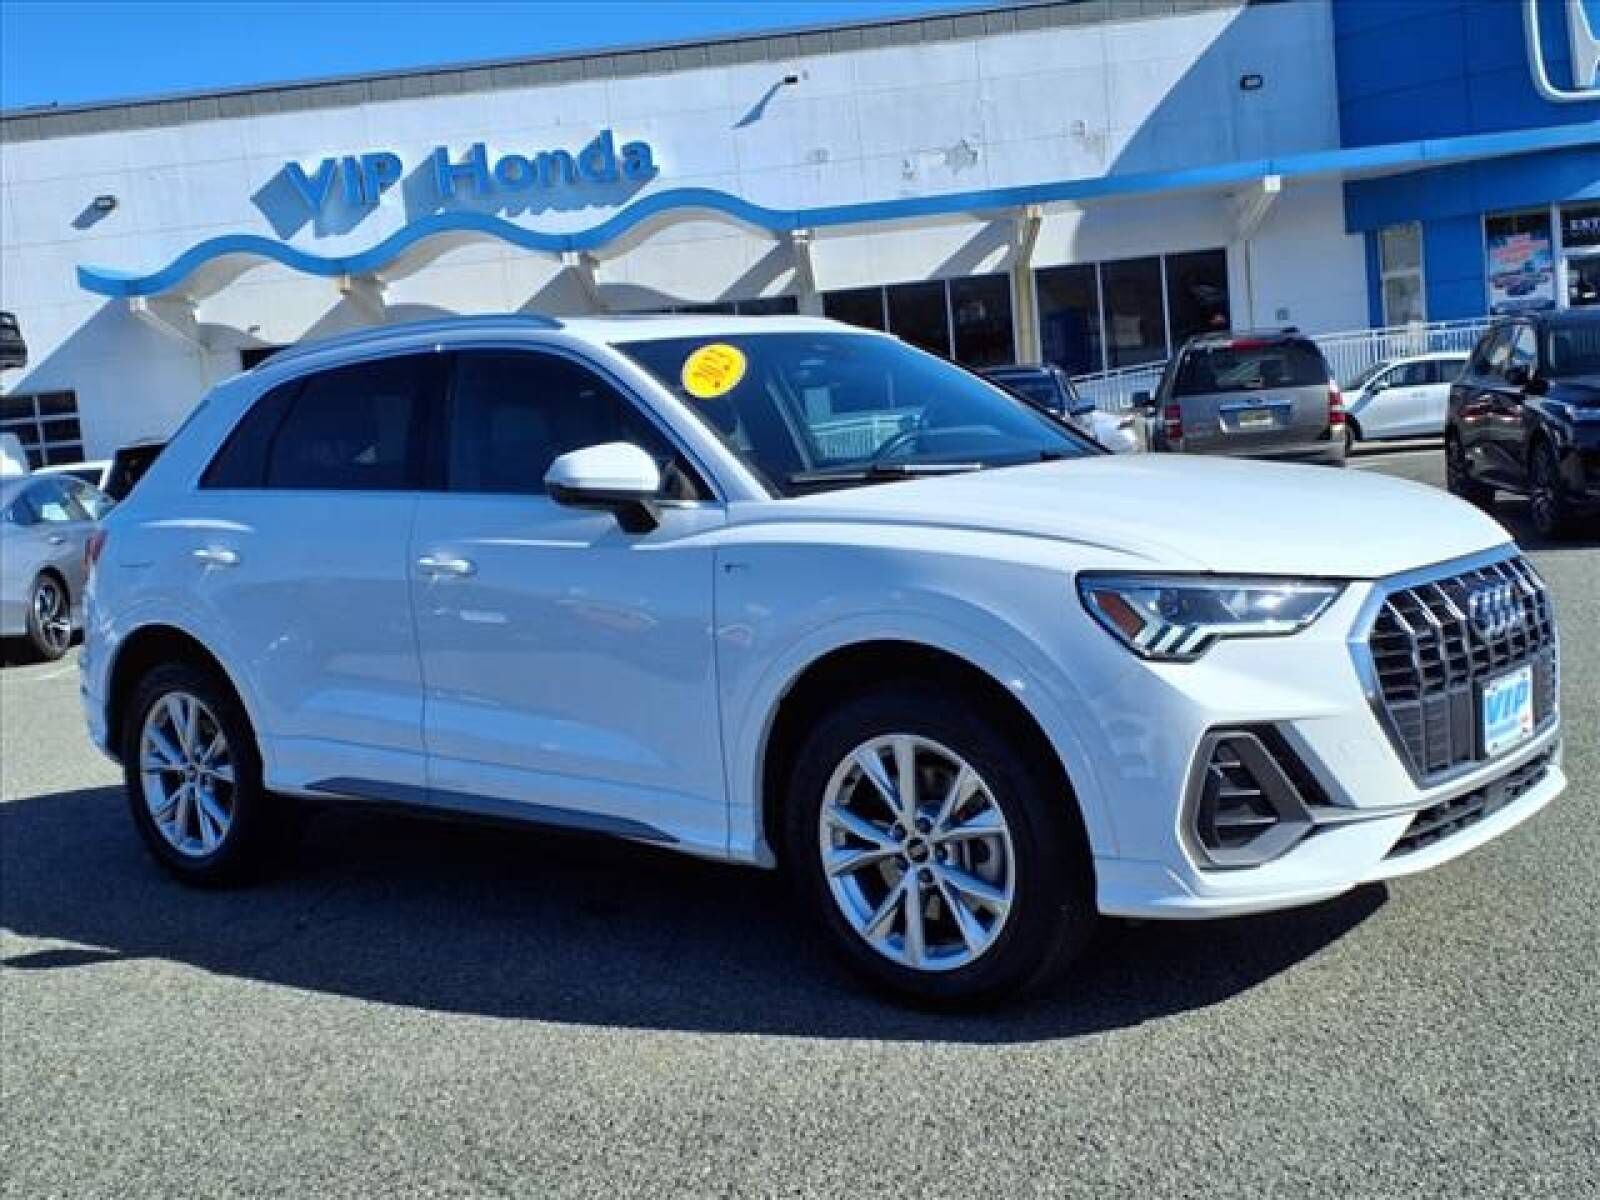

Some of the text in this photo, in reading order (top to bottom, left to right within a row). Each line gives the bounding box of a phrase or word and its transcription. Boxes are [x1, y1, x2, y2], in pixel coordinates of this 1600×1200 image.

[285, 130, 654, 206] VIP Honda
[1486, 680, 1529, 724] VIP
